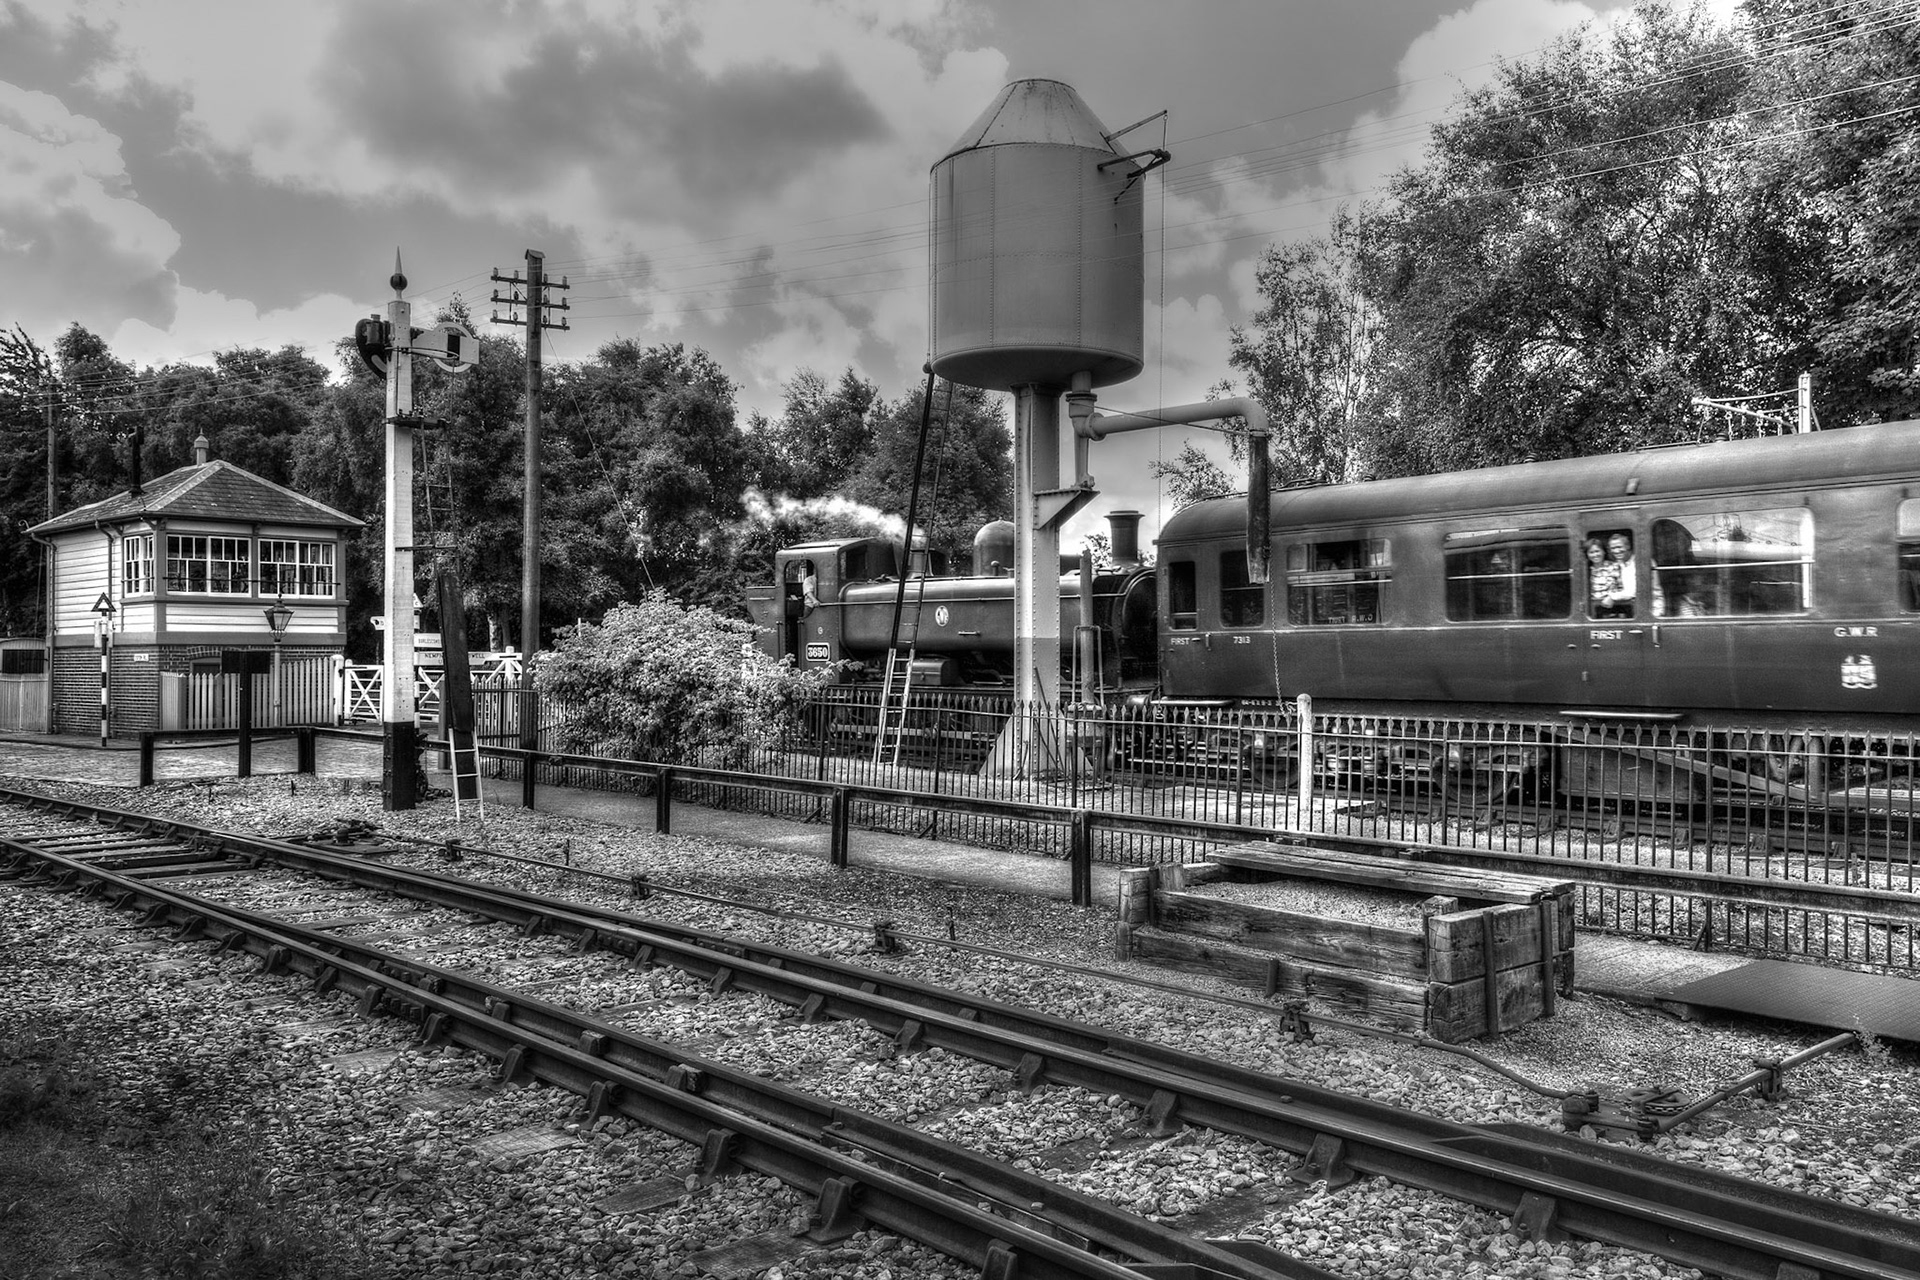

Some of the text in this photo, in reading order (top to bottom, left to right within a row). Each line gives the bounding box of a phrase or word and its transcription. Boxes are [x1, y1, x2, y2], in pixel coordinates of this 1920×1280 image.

[1590, 629, 1623, 640] FIRST
[1170, 637, 1190, 645] FIRST
[1233, 636, 1251, 644] 7313
[807, 647, 828, 658] 3650
